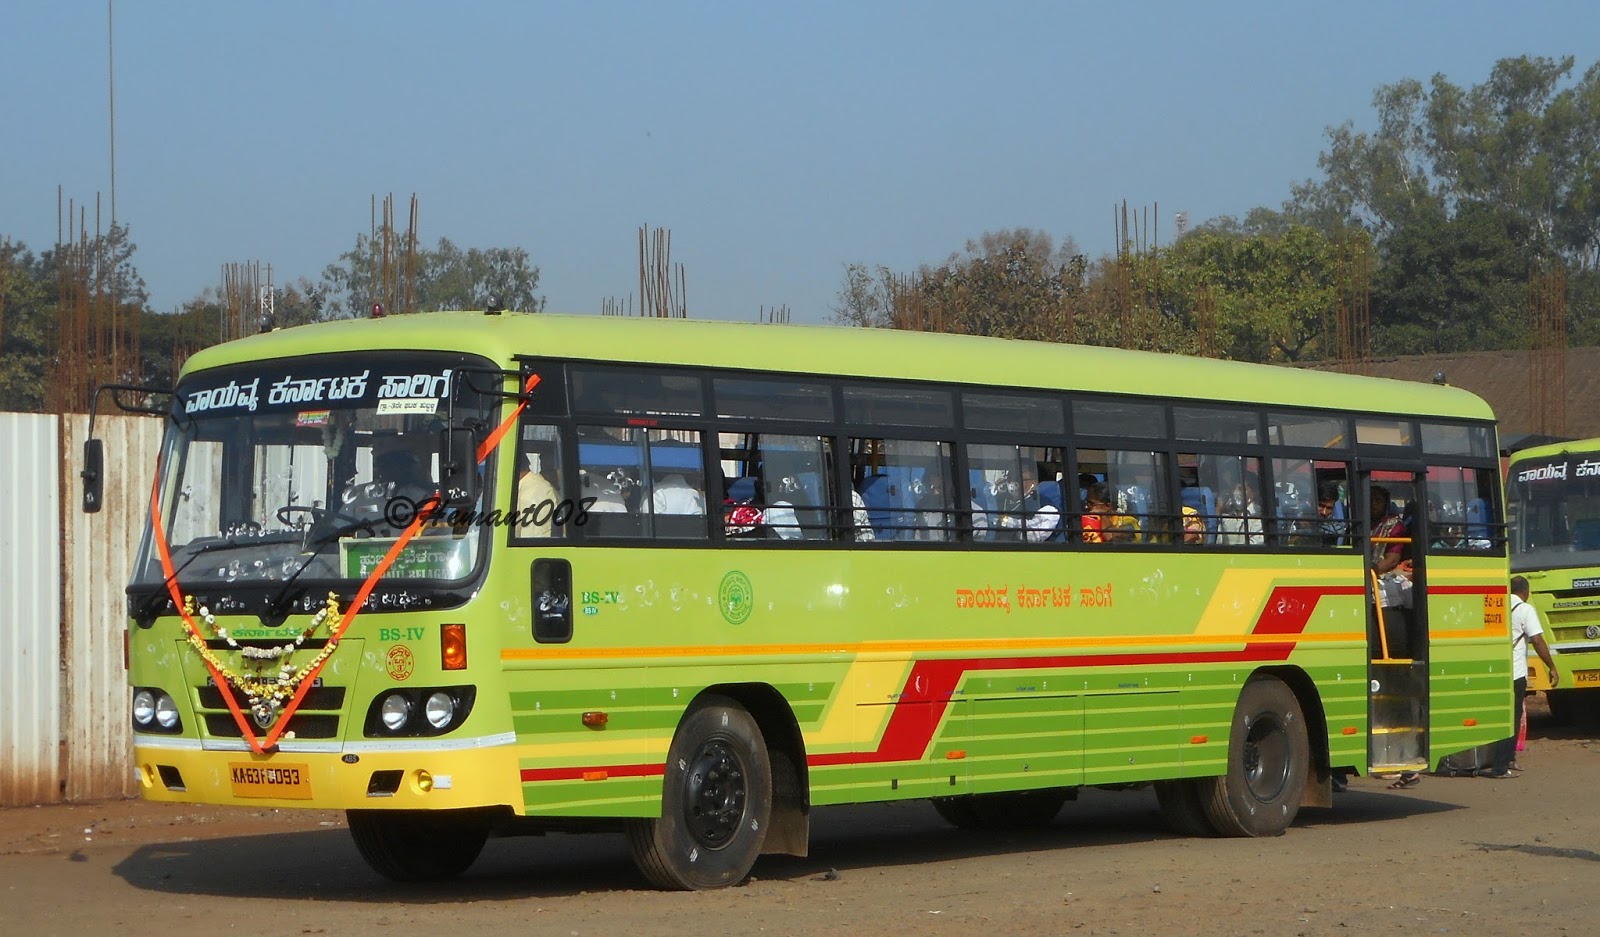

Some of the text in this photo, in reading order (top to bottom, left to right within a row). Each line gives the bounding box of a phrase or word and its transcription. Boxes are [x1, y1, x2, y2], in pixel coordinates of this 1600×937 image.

[185, 369, 453, 414] ವಾಯವ್ಯ ಕರ್ನಾಟಕ ಸಾರಿಗೆ
[1518, 461, 1568, 482] ವಾಯವ್ಯ
[581, 591, 620, 605] BS-IV
[956, 582, 1113, 613] ವಾಯವ್ಯ ಕರ್ನಾಟಕ ಸಾರಿಗೆ
[380, 627, 425, 642] BS-IV
[344, 755, 357, 763] ABS
